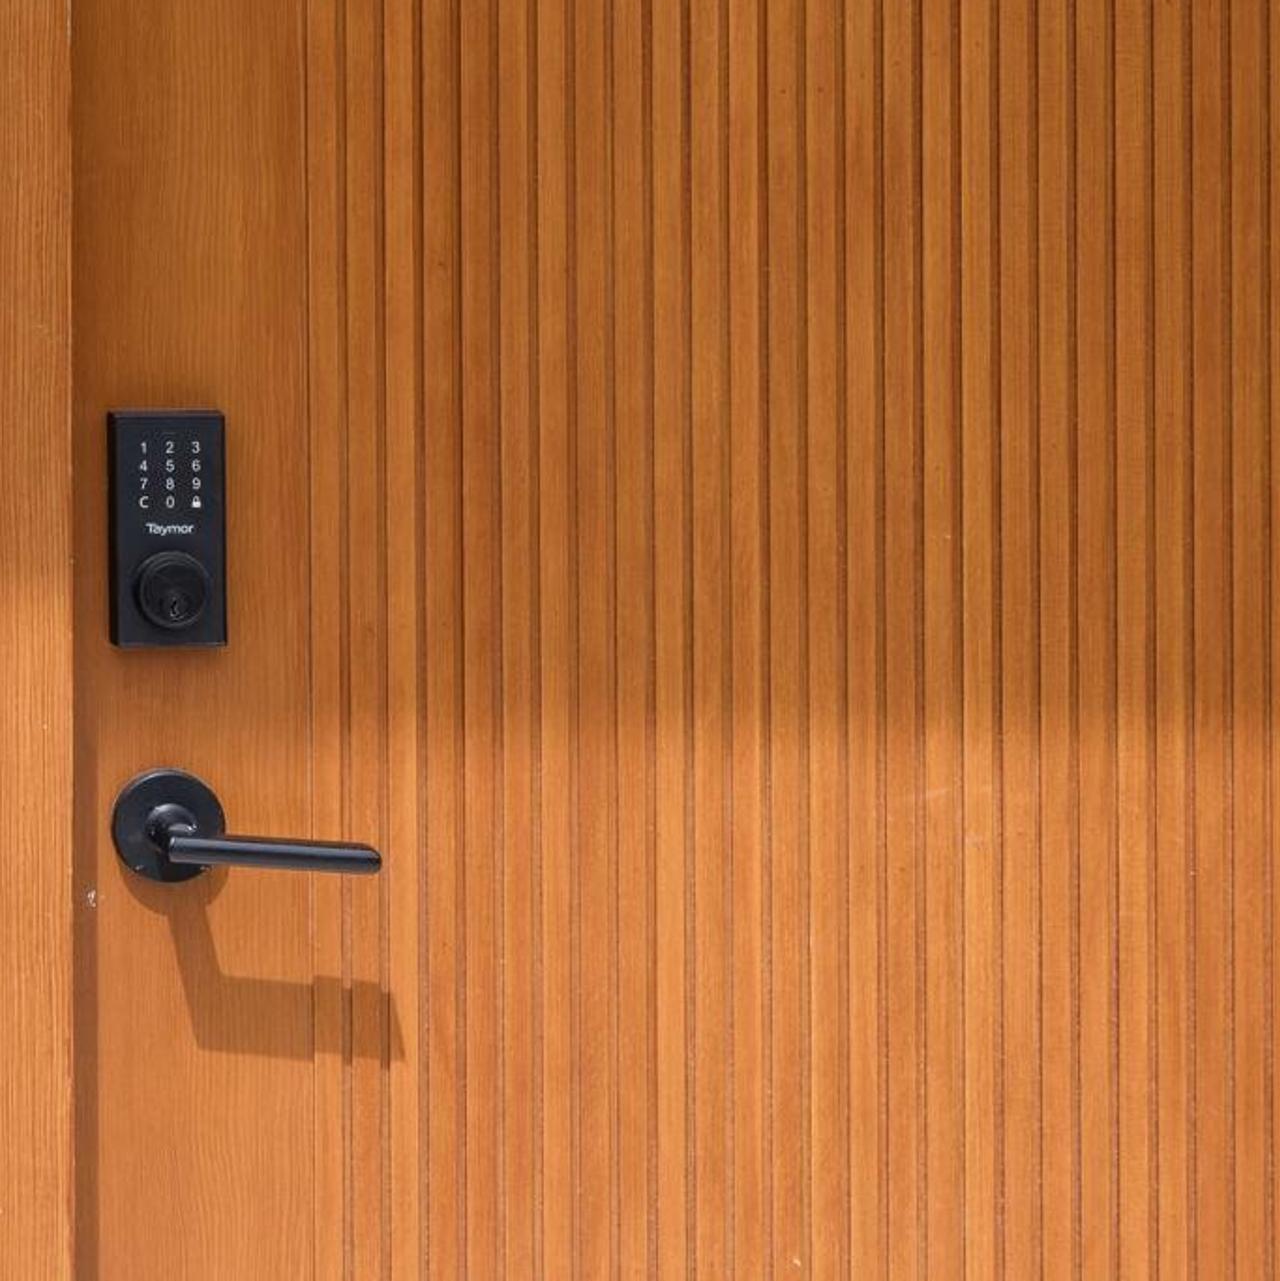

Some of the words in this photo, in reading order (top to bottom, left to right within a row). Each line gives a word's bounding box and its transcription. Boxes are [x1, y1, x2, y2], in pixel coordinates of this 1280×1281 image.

[140, 441, 147, 454] 1
[166, 441, 175, 454] 2
[192, 441, 201, 454] 3
[139, 460, 148, 471] 4
[166, 460, 175, 472] 5
[192, 459, 201, 472] 6
[140, 478, 148, 489] 7
[166, 477, 175, 490] 8
[192, 477, 201, 490] 9
[139, 495, 149, 508] C
[166, 496, 175, 508] 0
[145, 522, 194, 536] Taymor
